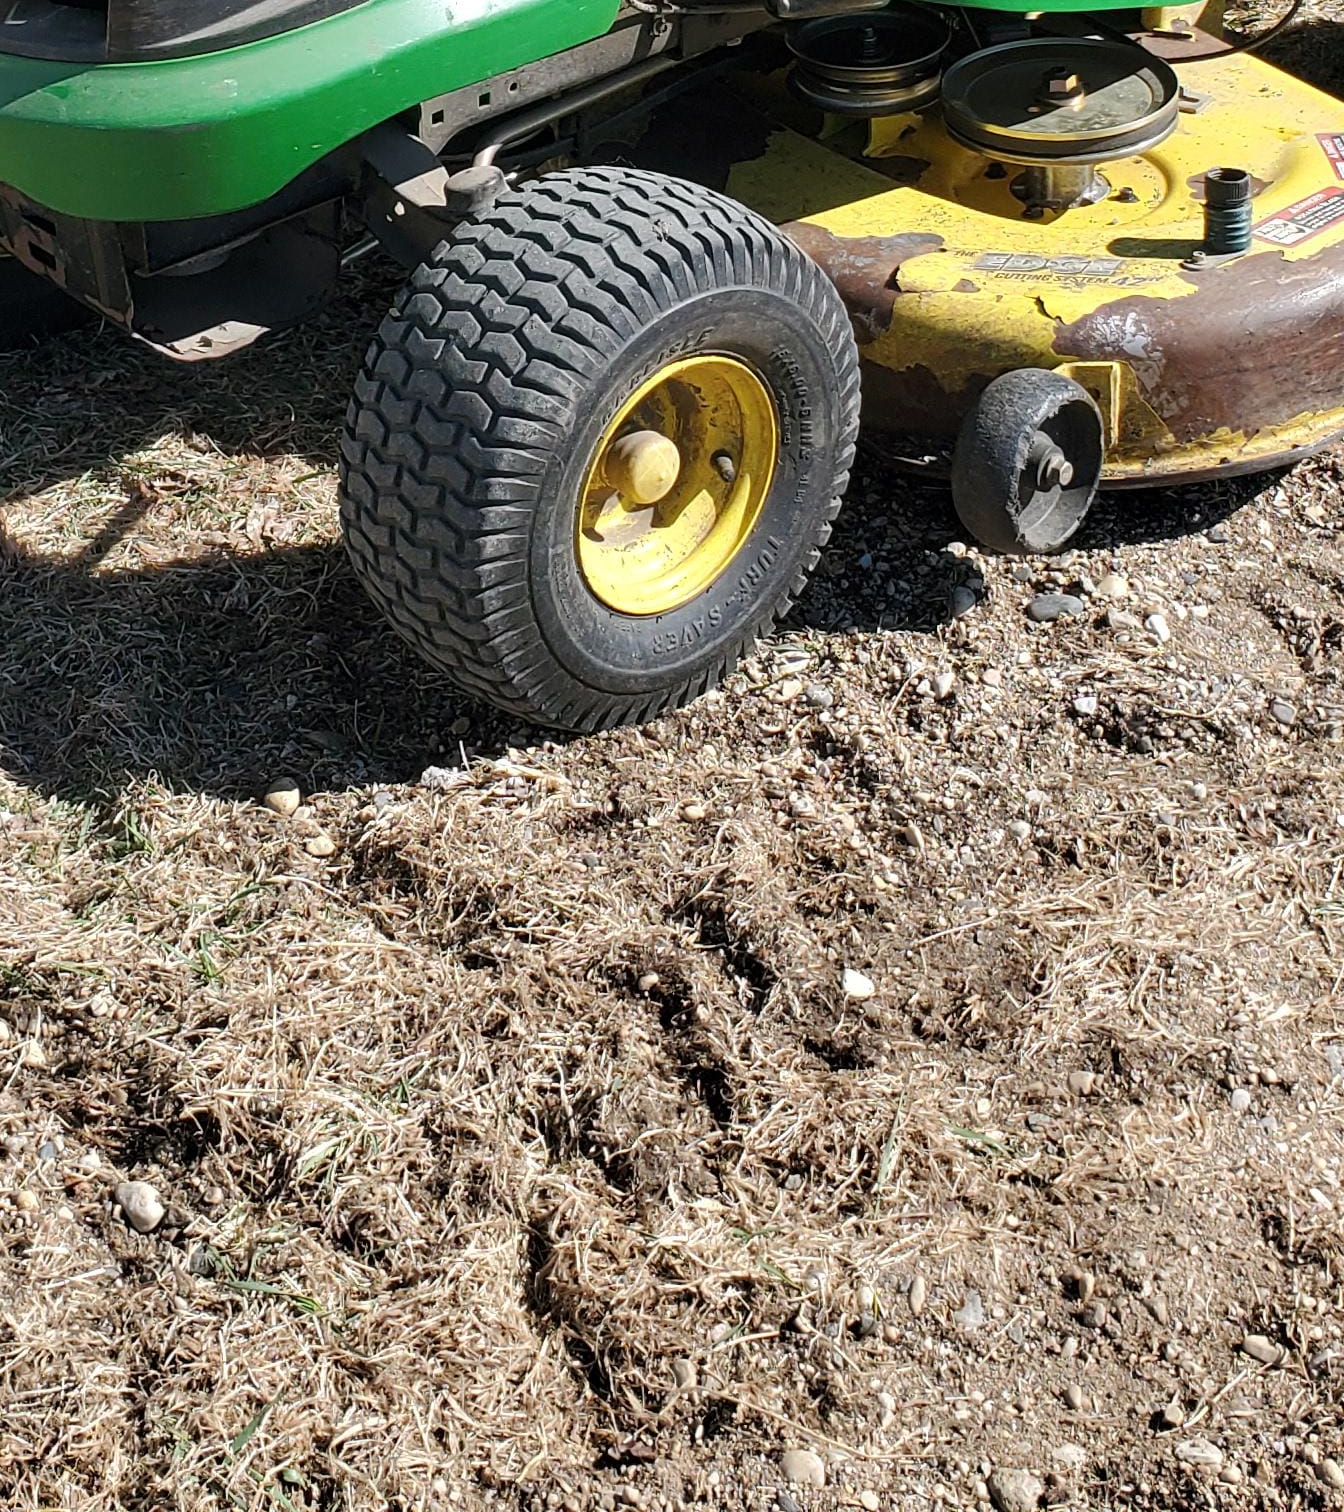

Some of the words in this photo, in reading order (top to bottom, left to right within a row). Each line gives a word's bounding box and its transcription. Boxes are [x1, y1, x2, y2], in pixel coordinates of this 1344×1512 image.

[972, 253, 1123, 276] EDGE
[994, 273, 1051, 281] CUTTING
[1055, 275, 1109, 284] SYSTEM
